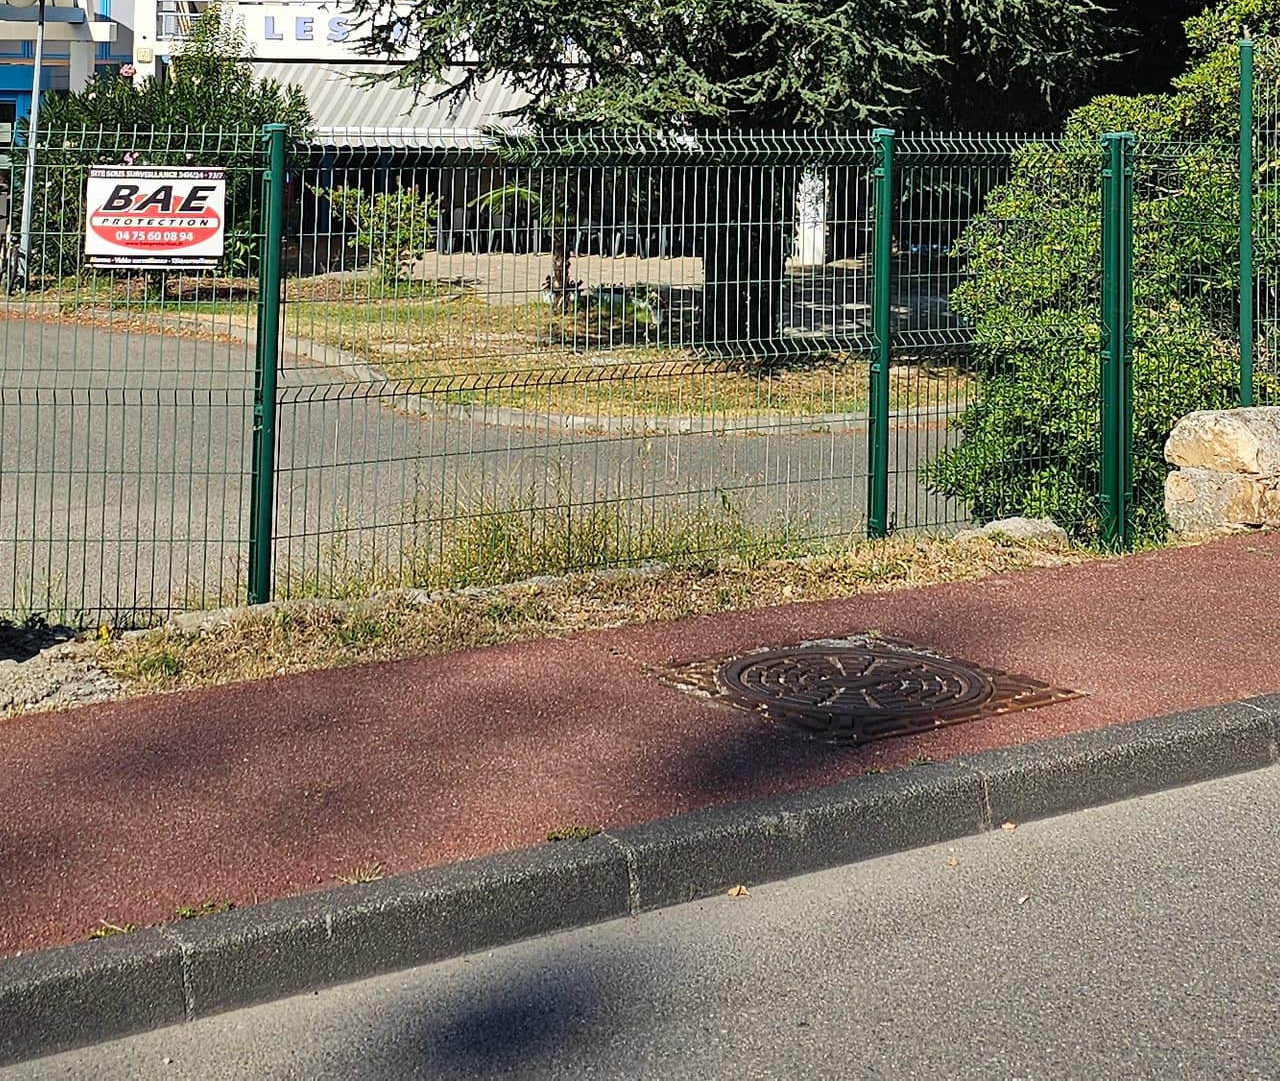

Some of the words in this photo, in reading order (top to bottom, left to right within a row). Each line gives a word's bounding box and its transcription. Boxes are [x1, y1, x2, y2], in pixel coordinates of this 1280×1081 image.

[264, 16, 349, 42] LES
[90, 169, 105, 177] SITE
[126, 170, 177, 178] SURVEILLANCE
[102, 185, 217, 212] BAE
[102, 218, 209, 226] PROTECTION
[116, 230, 130, 240] 04
[132, 231, 146, 240] 75
[147, 231, 161, 240] 60
[163, 231, 178, 241] 08
[179, 231, 193, 241] 94
